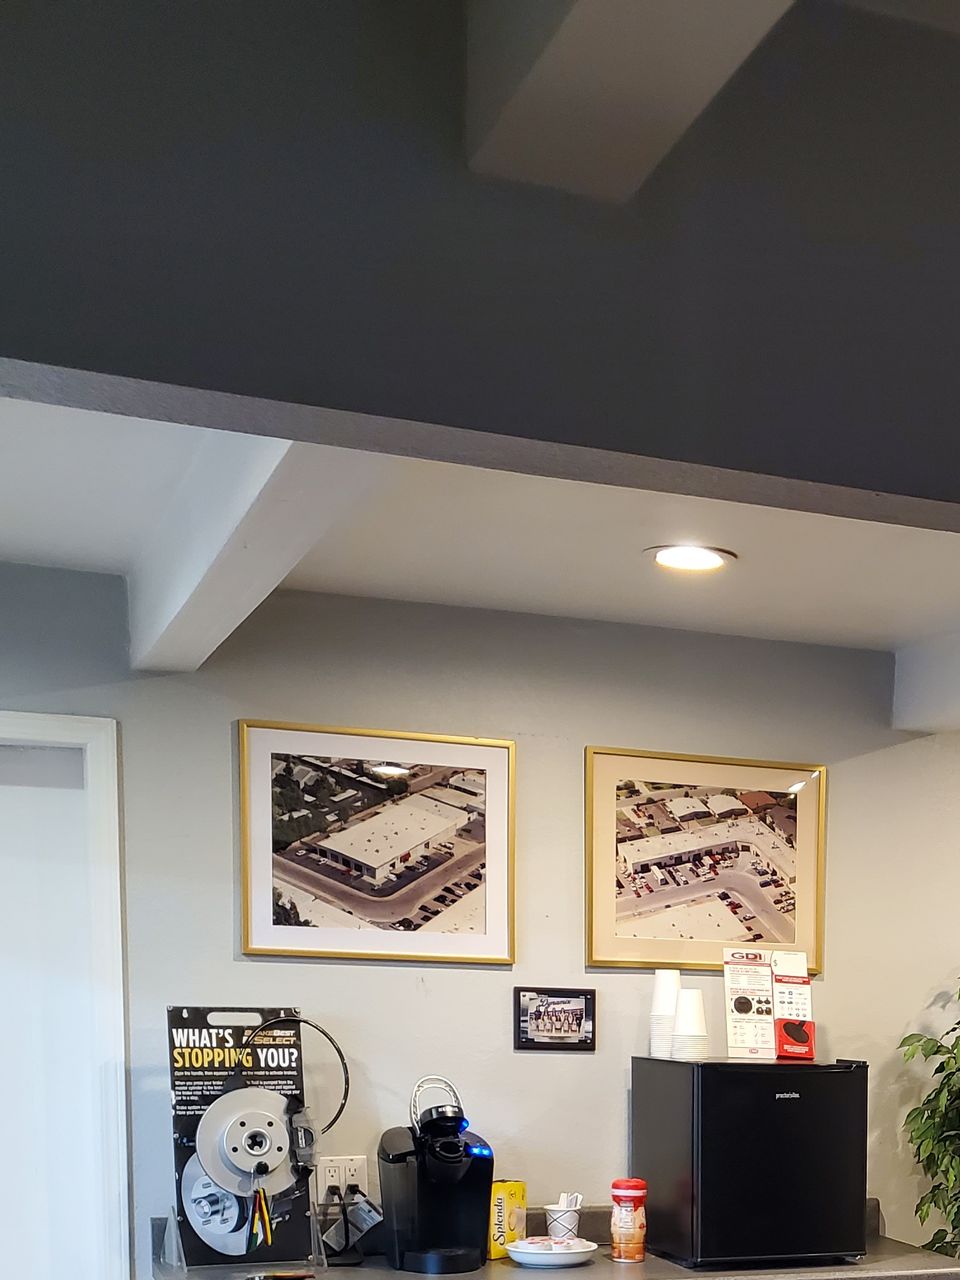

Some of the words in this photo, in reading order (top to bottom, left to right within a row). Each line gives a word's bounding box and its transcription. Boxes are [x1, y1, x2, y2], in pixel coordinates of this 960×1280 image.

[731, 952, 762, 960] GDI
[172, 1028, 234, 1047] WHAT'S
[173, 1048, 253, 1067] STOPPING
[256, 1048, 298, 1067] YOU?
[492, 1197, 506, 1246] Splenda
